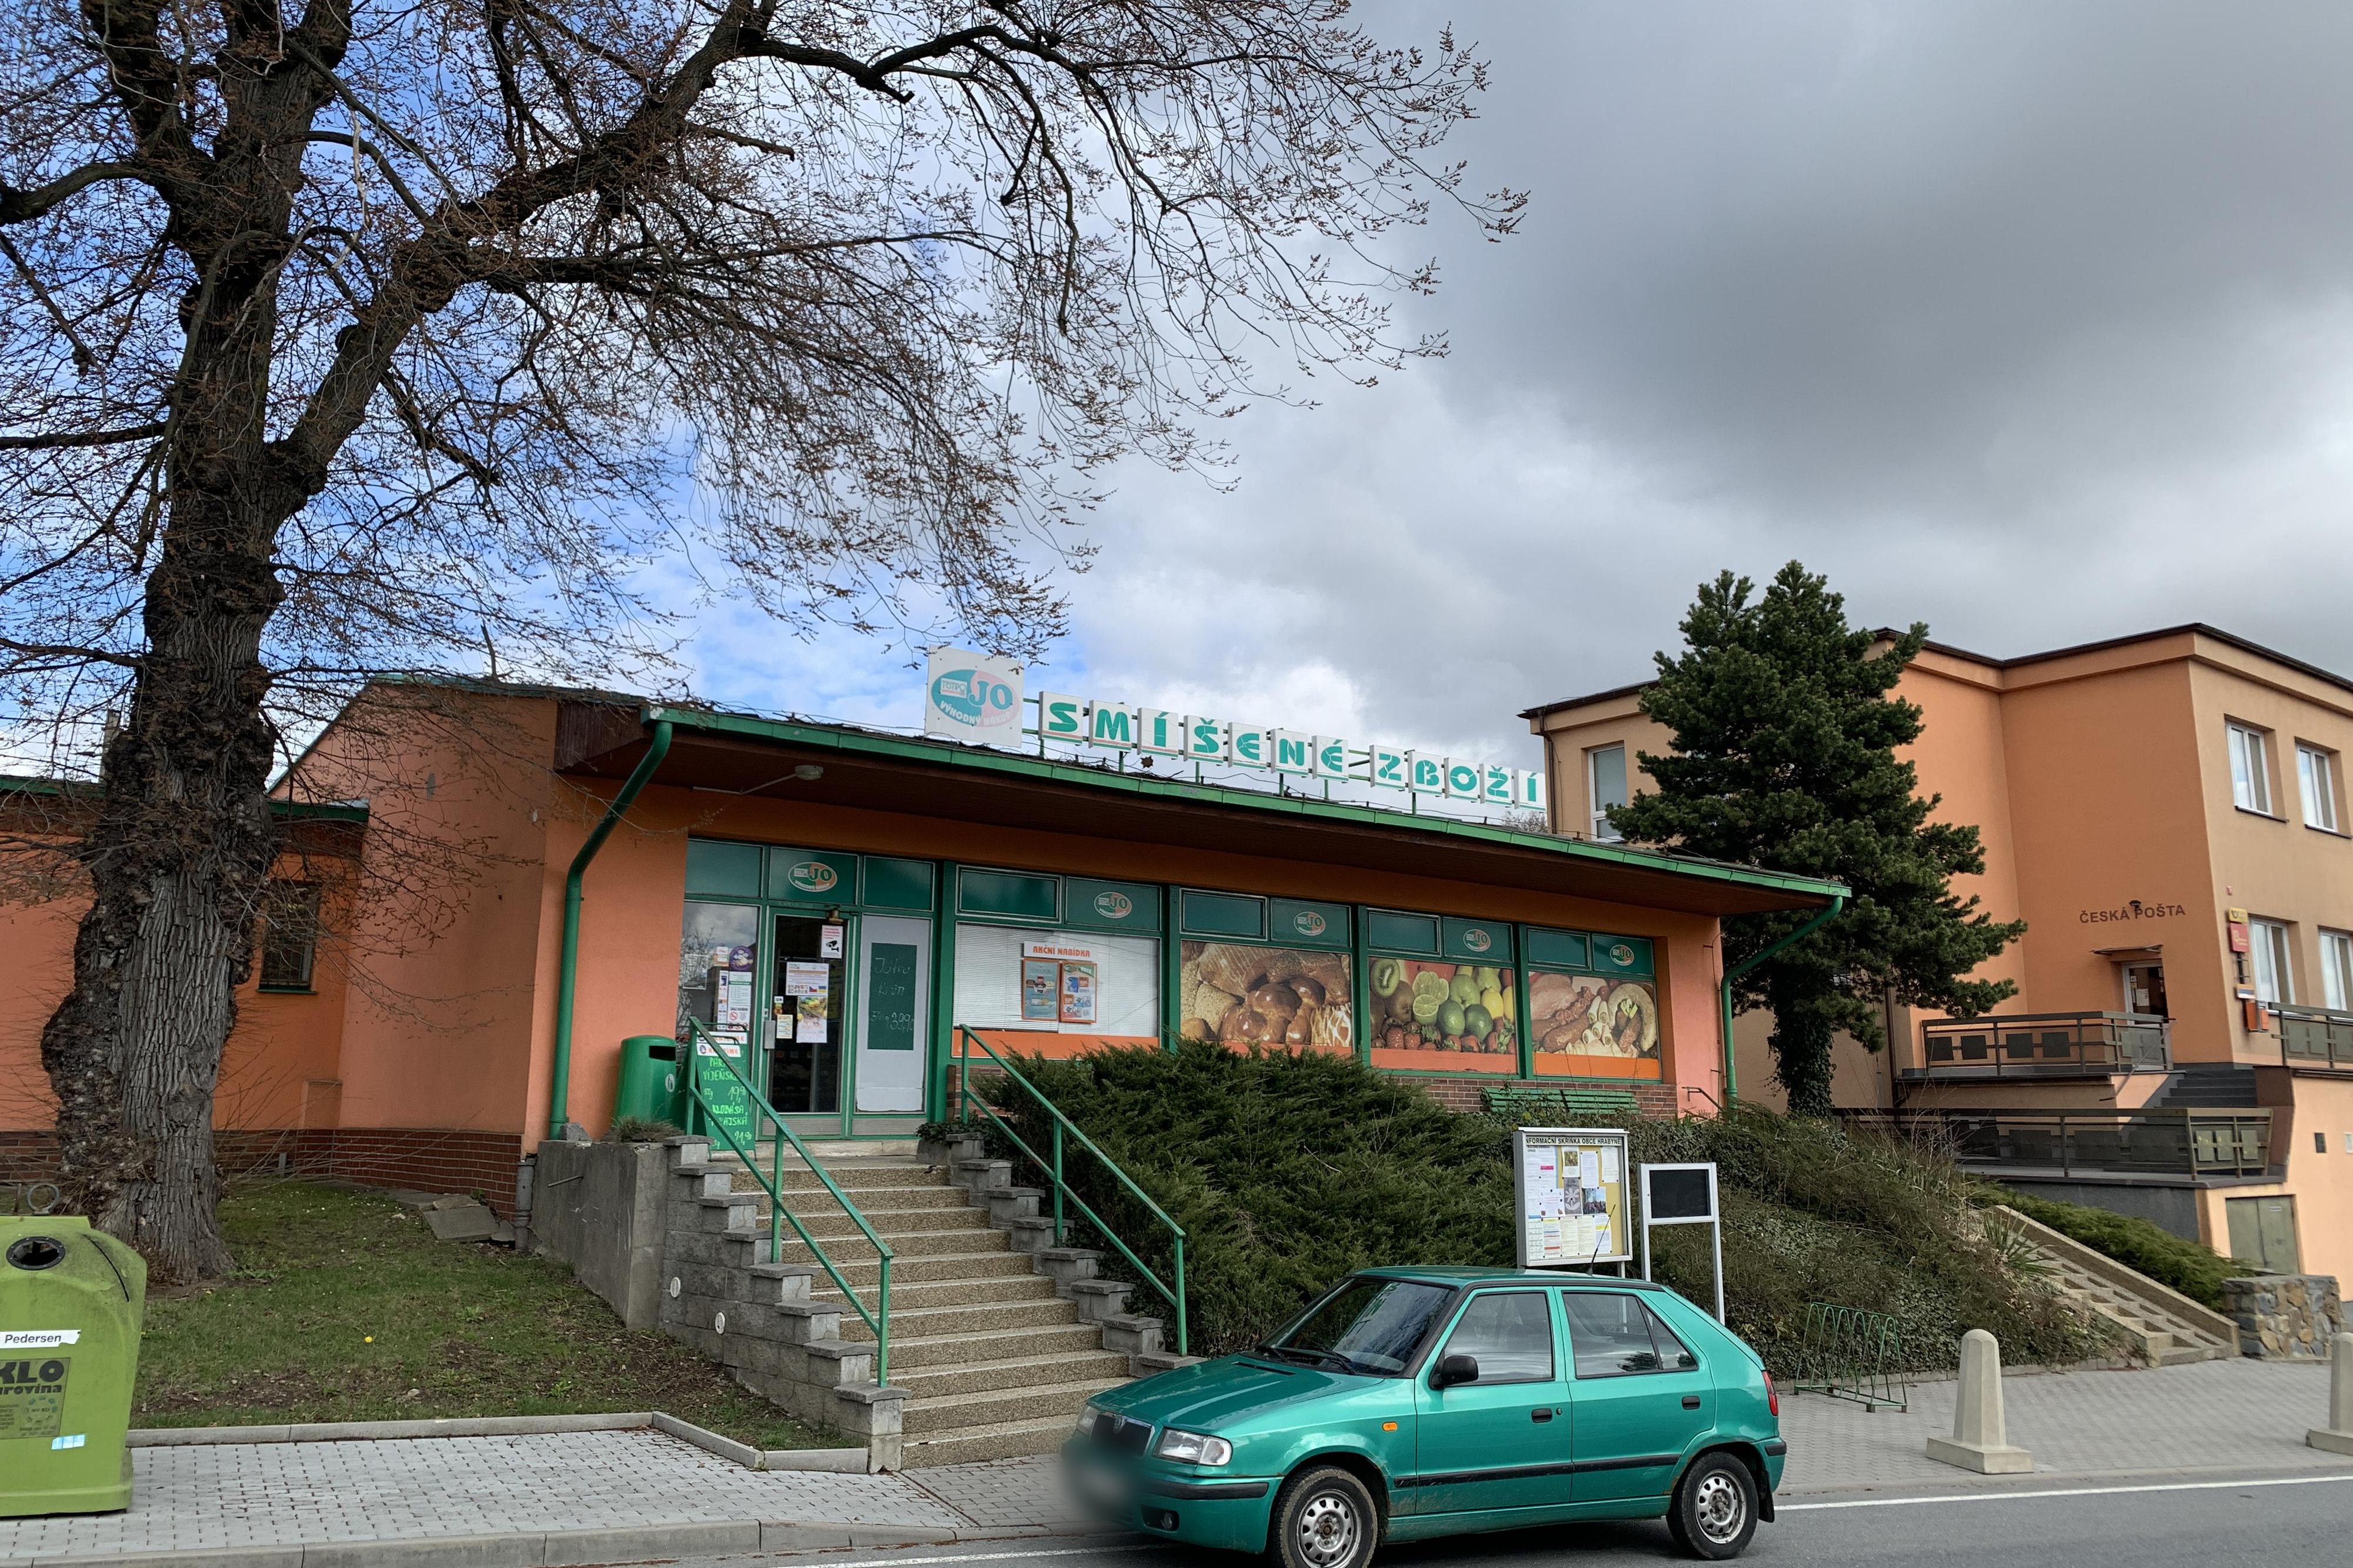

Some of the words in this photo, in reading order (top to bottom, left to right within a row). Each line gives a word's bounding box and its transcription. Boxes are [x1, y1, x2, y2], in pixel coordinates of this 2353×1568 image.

[968, 680, 1013, 710] JO
[939, 700, 981, 725] VÝHODNÝ
[1048, 702, 1343, 773] SMÍŠENÉ
[1378, 752, 1537, 802] ZBOŽÍ
[809, 868, 832, 881] JO
[1109, 898, 1128, 909] JO
[2079, 906, 2130, 923] ČESKÁ
[2134, 903, 2186, 919] POŠTA
[1032, 944, 1055, 954] AKČNÍ
[1058, 946, 1090, 958] NABÍDKA
[703, 1067, 738, 1081] VÍDEŇSK
[1526, 1136, 1557, 1144] NFORMAČNÍ
[4, 1334, 61, 1343] Pedersen
